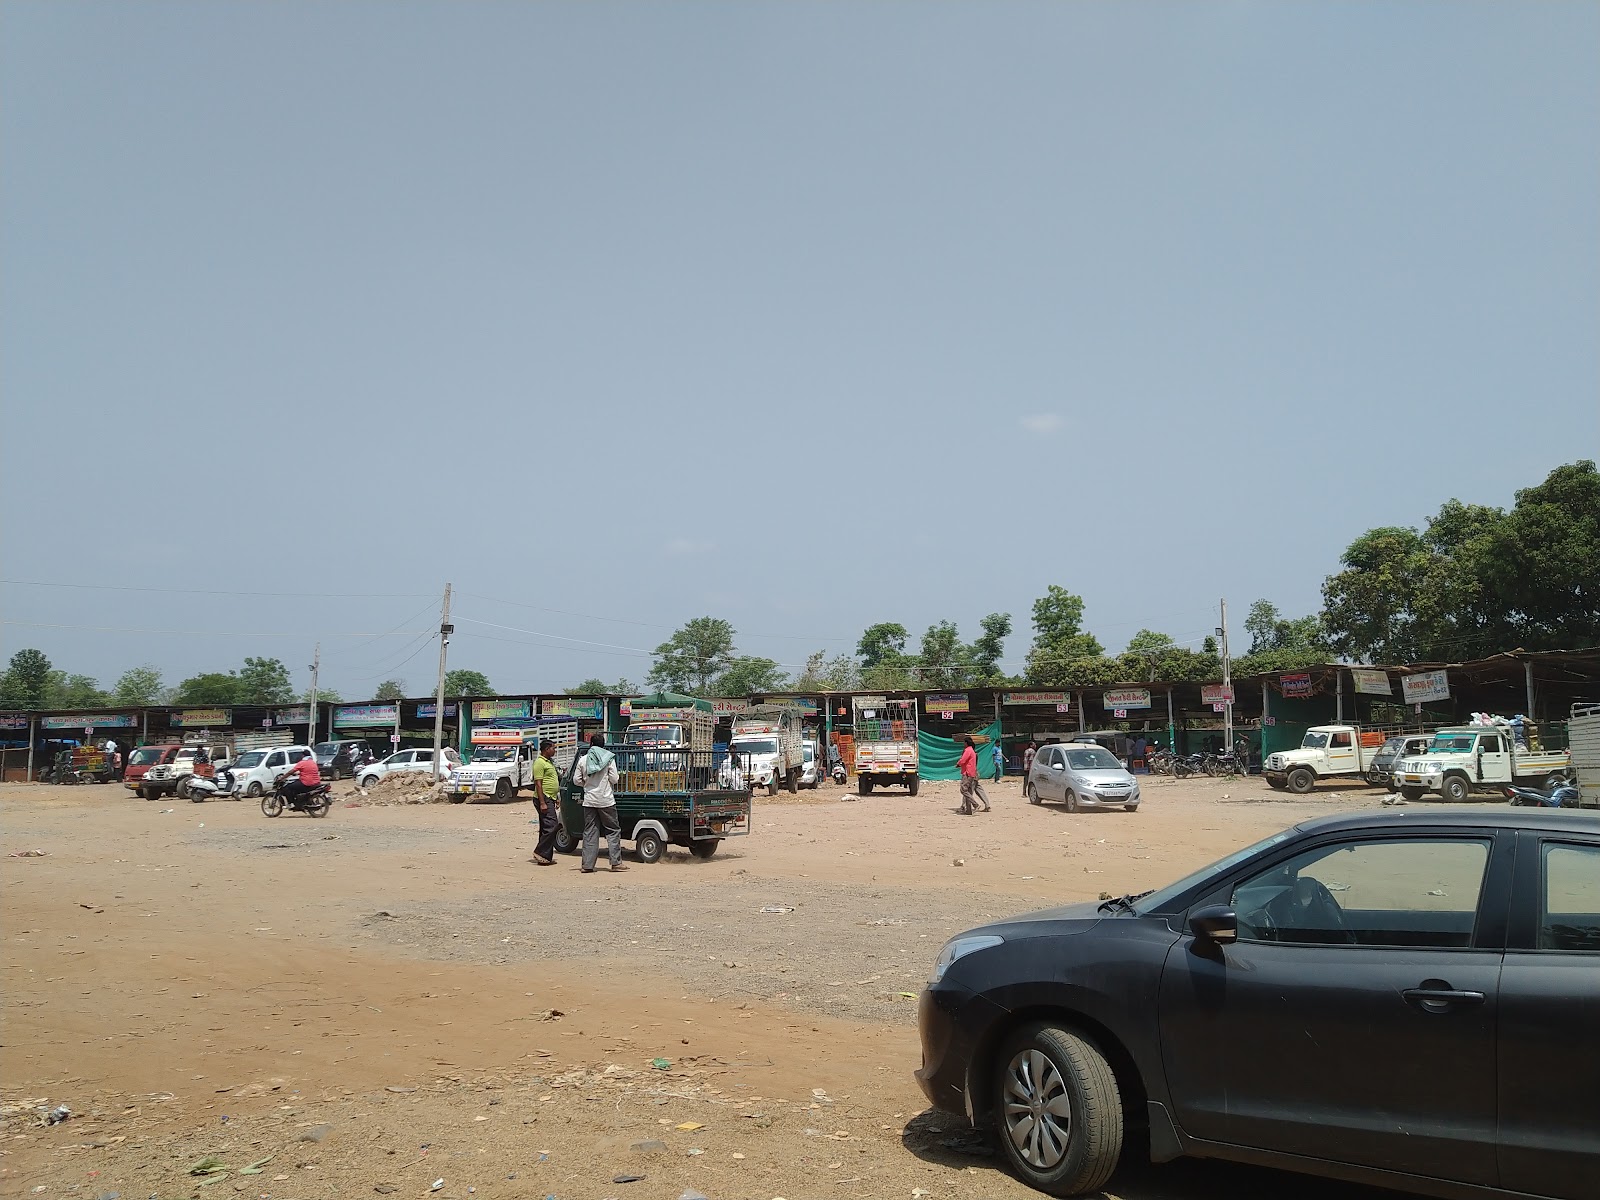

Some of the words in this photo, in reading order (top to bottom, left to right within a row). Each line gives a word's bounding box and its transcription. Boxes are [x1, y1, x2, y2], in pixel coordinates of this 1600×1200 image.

[1058, 704, 1067, 712] 53
[1215, 703, 1225, 712] 55
[943, 711, 952, 719] 52
[1115, 709, 1125, 717] 54
[1265, 716, 1274, 725] 56
[391, 735, 400, 743] 46
